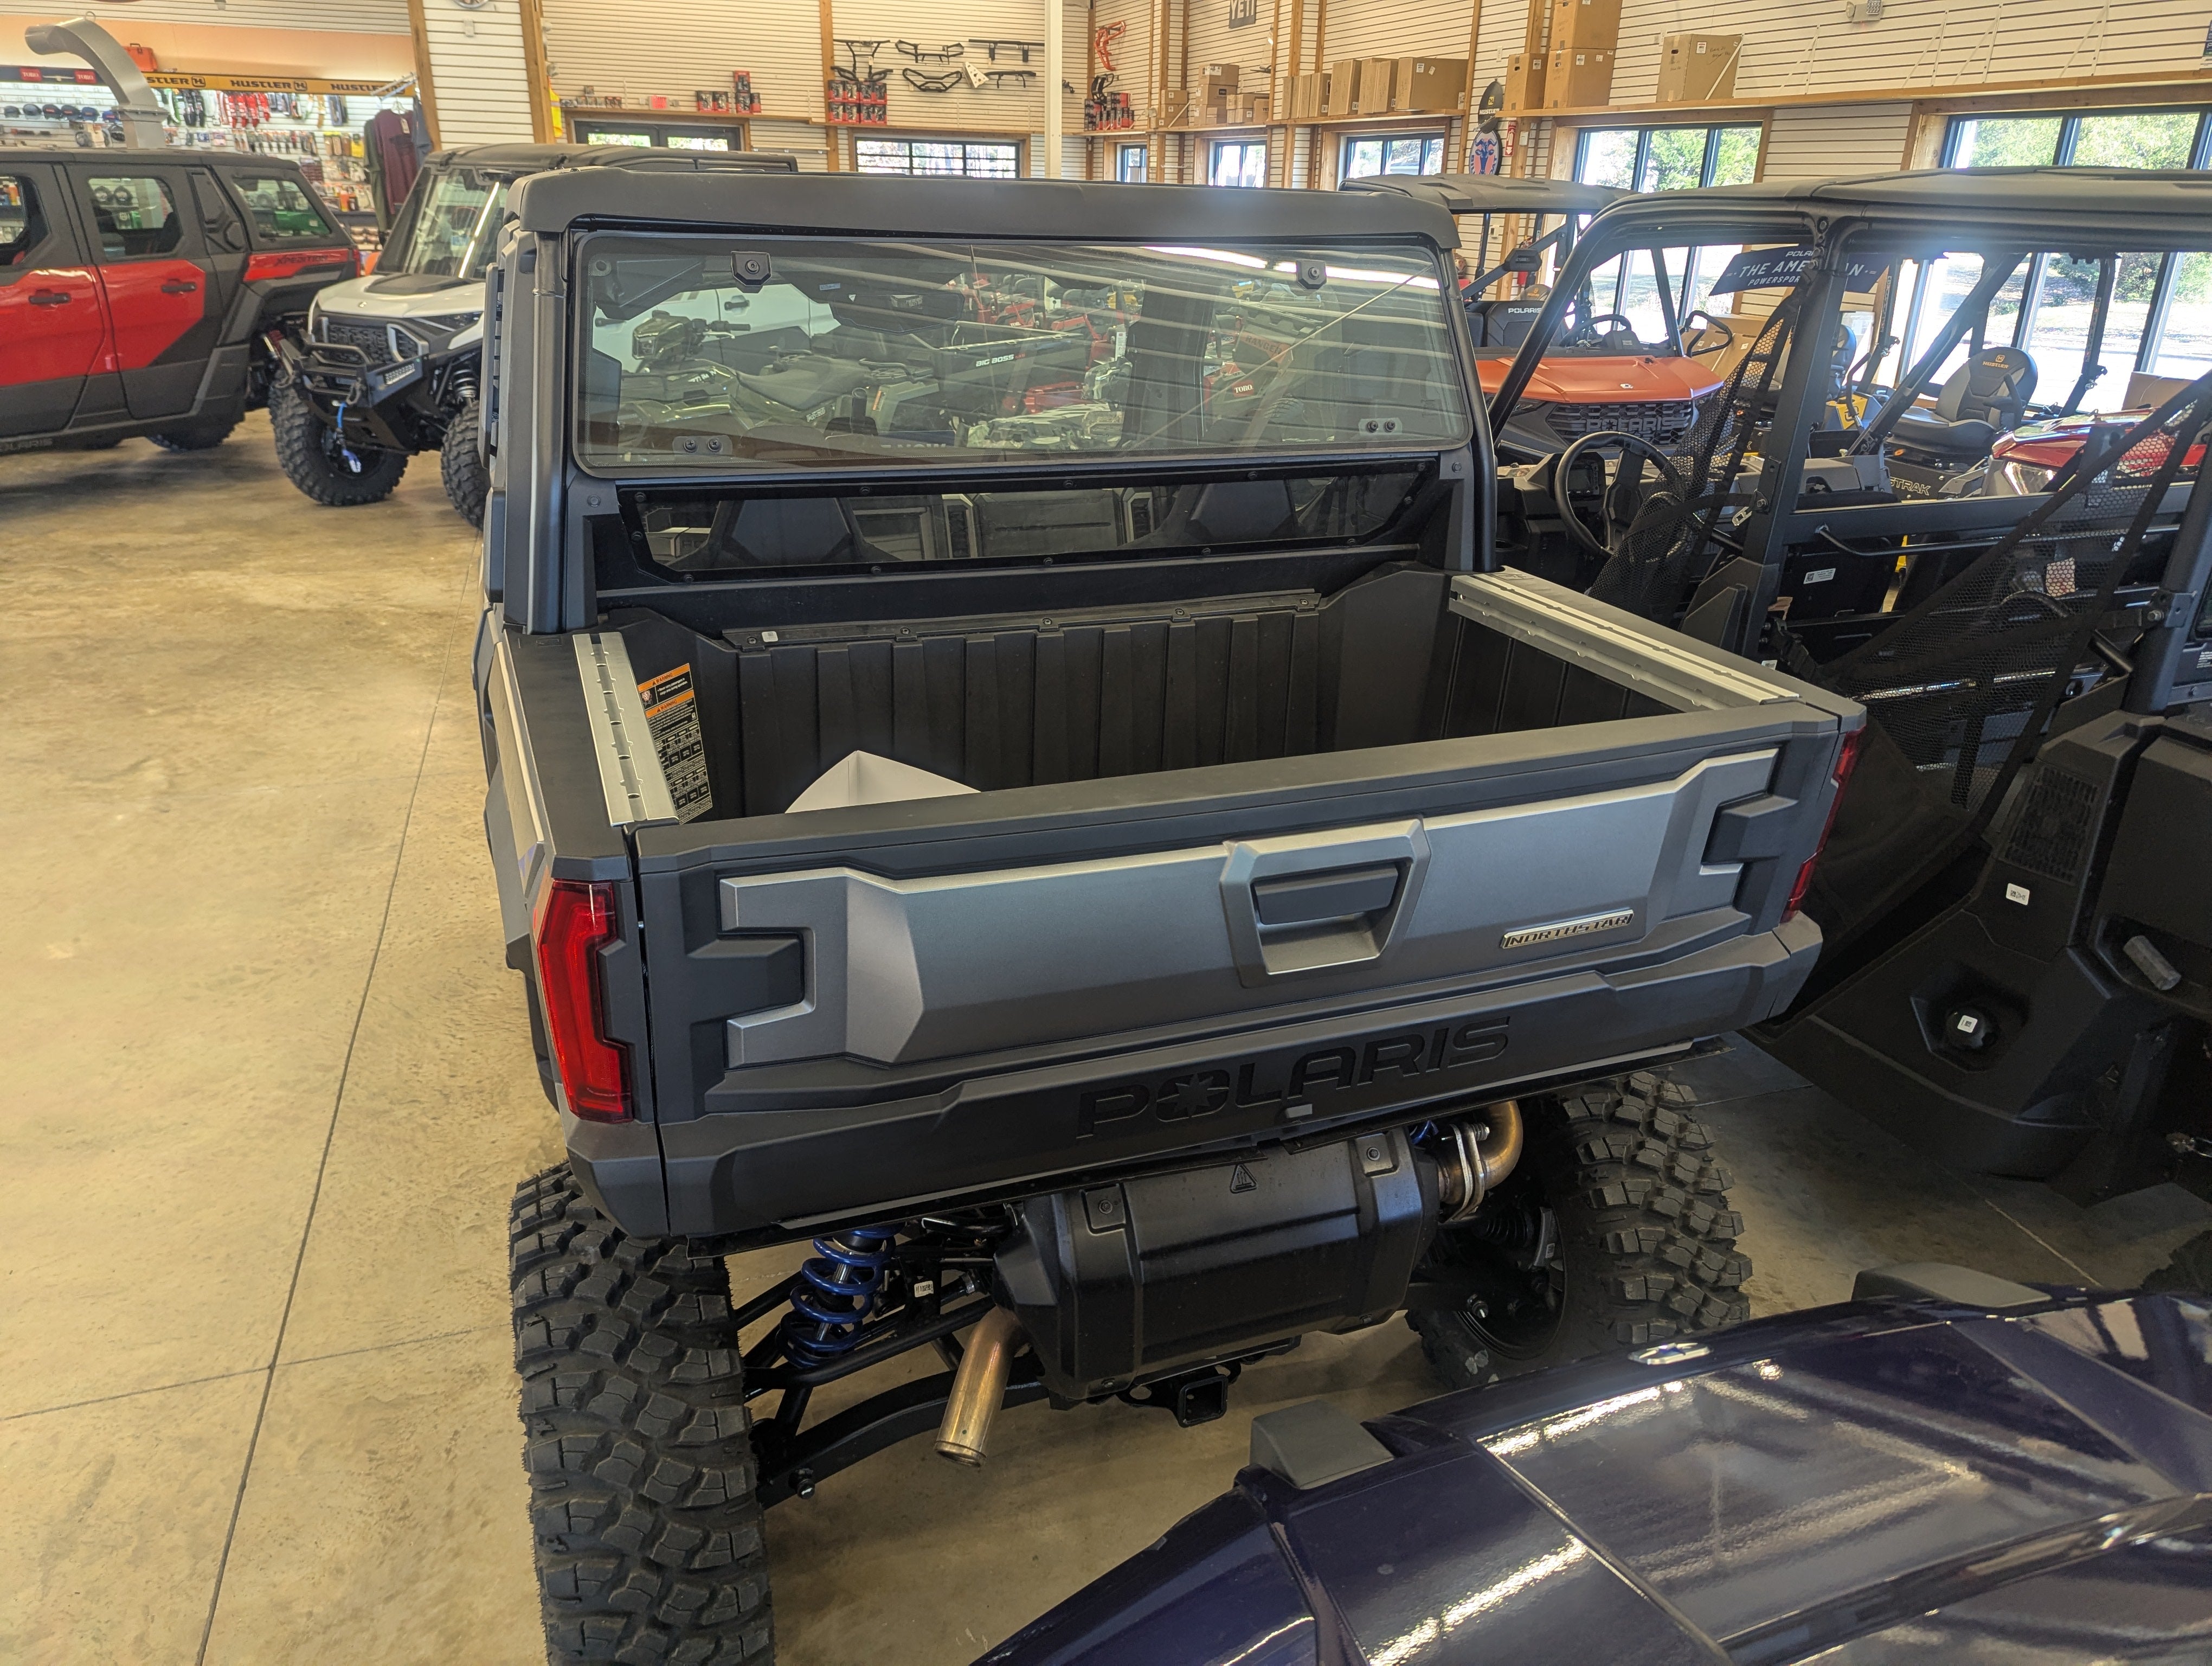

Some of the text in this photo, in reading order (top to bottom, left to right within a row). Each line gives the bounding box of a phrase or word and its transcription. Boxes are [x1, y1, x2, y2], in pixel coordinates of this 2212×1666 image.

[1230, 0, 1253, 19] YETI
[230, 80, 291, 88] HUSTLER
[1739, 263, 1770, 277] THE
[1748, 276, 1800, 285] POWERSPOR
[1245, 337, 1281, 354] RANGER
[992, 355, 1014, 363] BOSS
[1586, 416, 1677, 432] POLARIS
[1890, 477, 1931, 495] STRAK
[657, 673, 673, 683] WARNING
[660, 700, 677, 709] WARNING
[1509, 916, 1628, 945] NORTHSTAR
[1076, 1016, 1510, 1139] POLARIS
